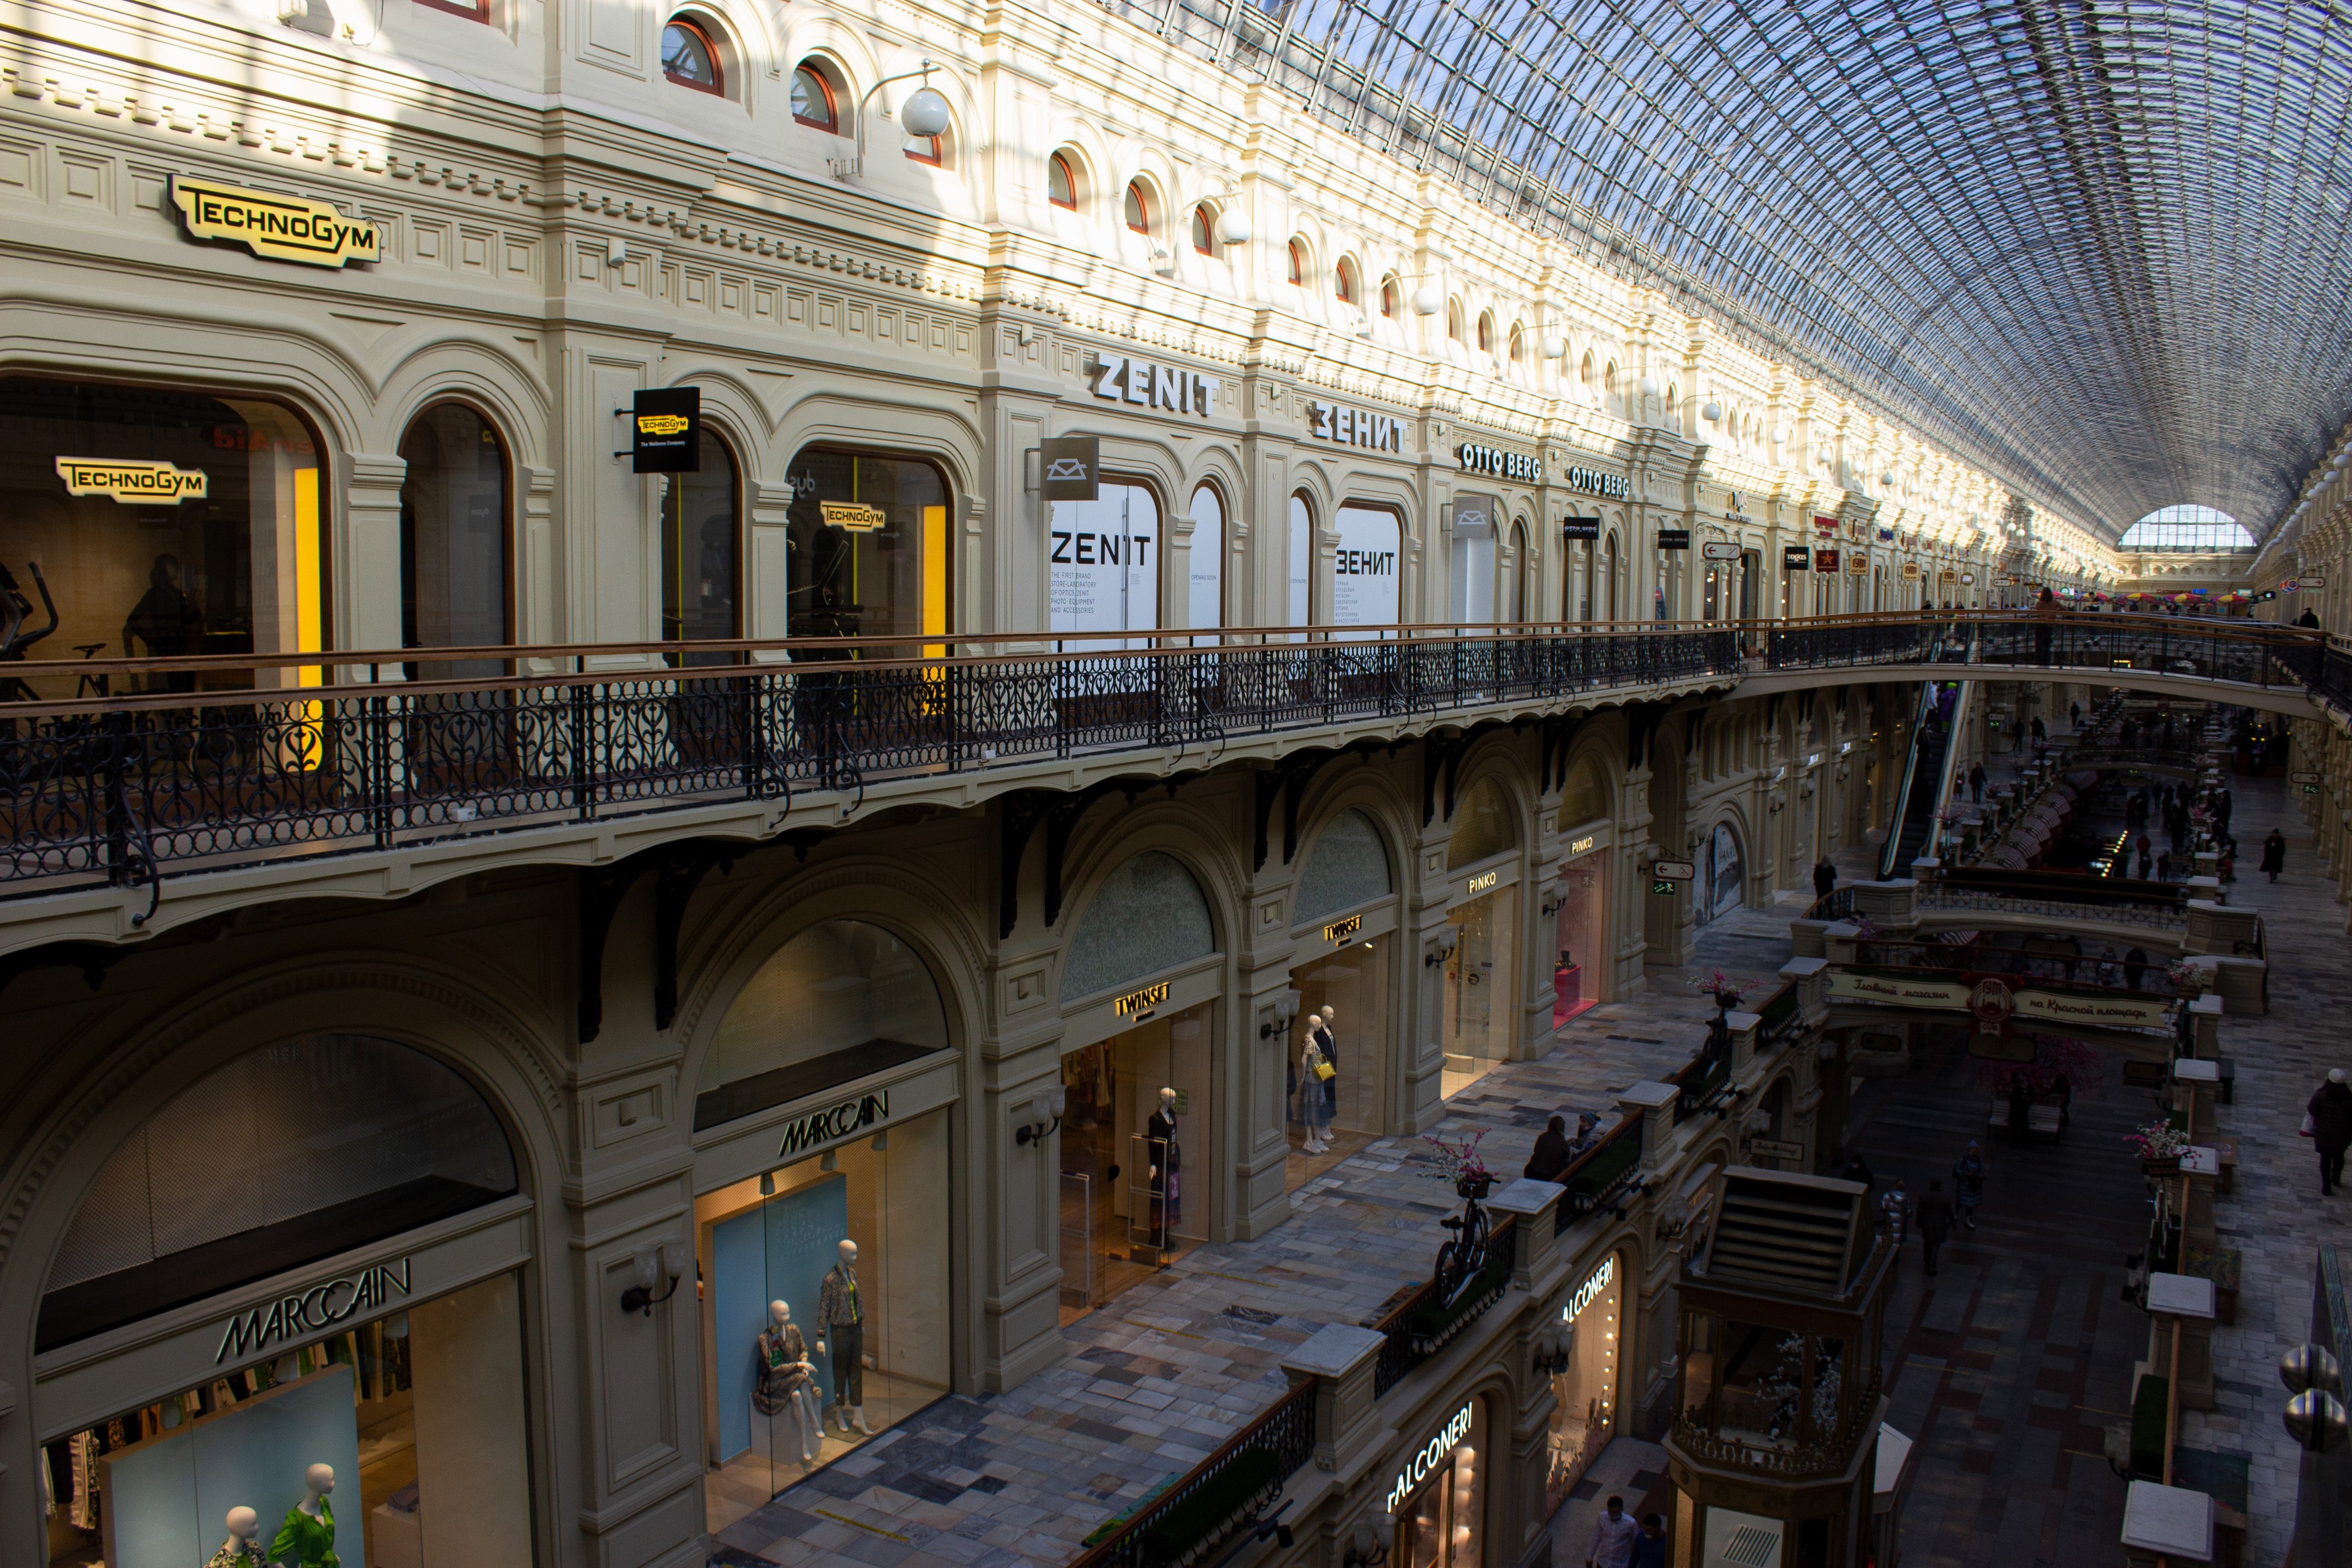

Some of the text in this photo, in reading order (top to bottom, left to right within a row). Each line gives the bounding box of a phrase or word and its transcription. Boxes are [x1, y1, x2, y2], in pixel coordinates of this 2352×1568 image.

[1094, 353, 1220, 415] ZENIT
[1312, 402, 1408, 452] ЗЕНИТ
[1462, 443, 1542, 480] OTTO BERG
[1571, 466, 1630, 497] OTTO BERG
[1052, 531, 1150, 566] ZENIT
[1337, 551, 1394, 575] ЗЕНИТ
[1571, 836, 1593, 854] PINKO
[1469, 872, 1496, 894] PINKO
[1324, 915, 1363, 942] TWINSET
[1115, 982, 1172, 1017] TWINSET
[1854, 978, 1950, 999] Главный магазин
[1983, 981, 2002, 995] ГУМ
[2030, 999, 2147, 1019] на Красной площади
[1563, 1257, 1613, 1323] ALCONERI
